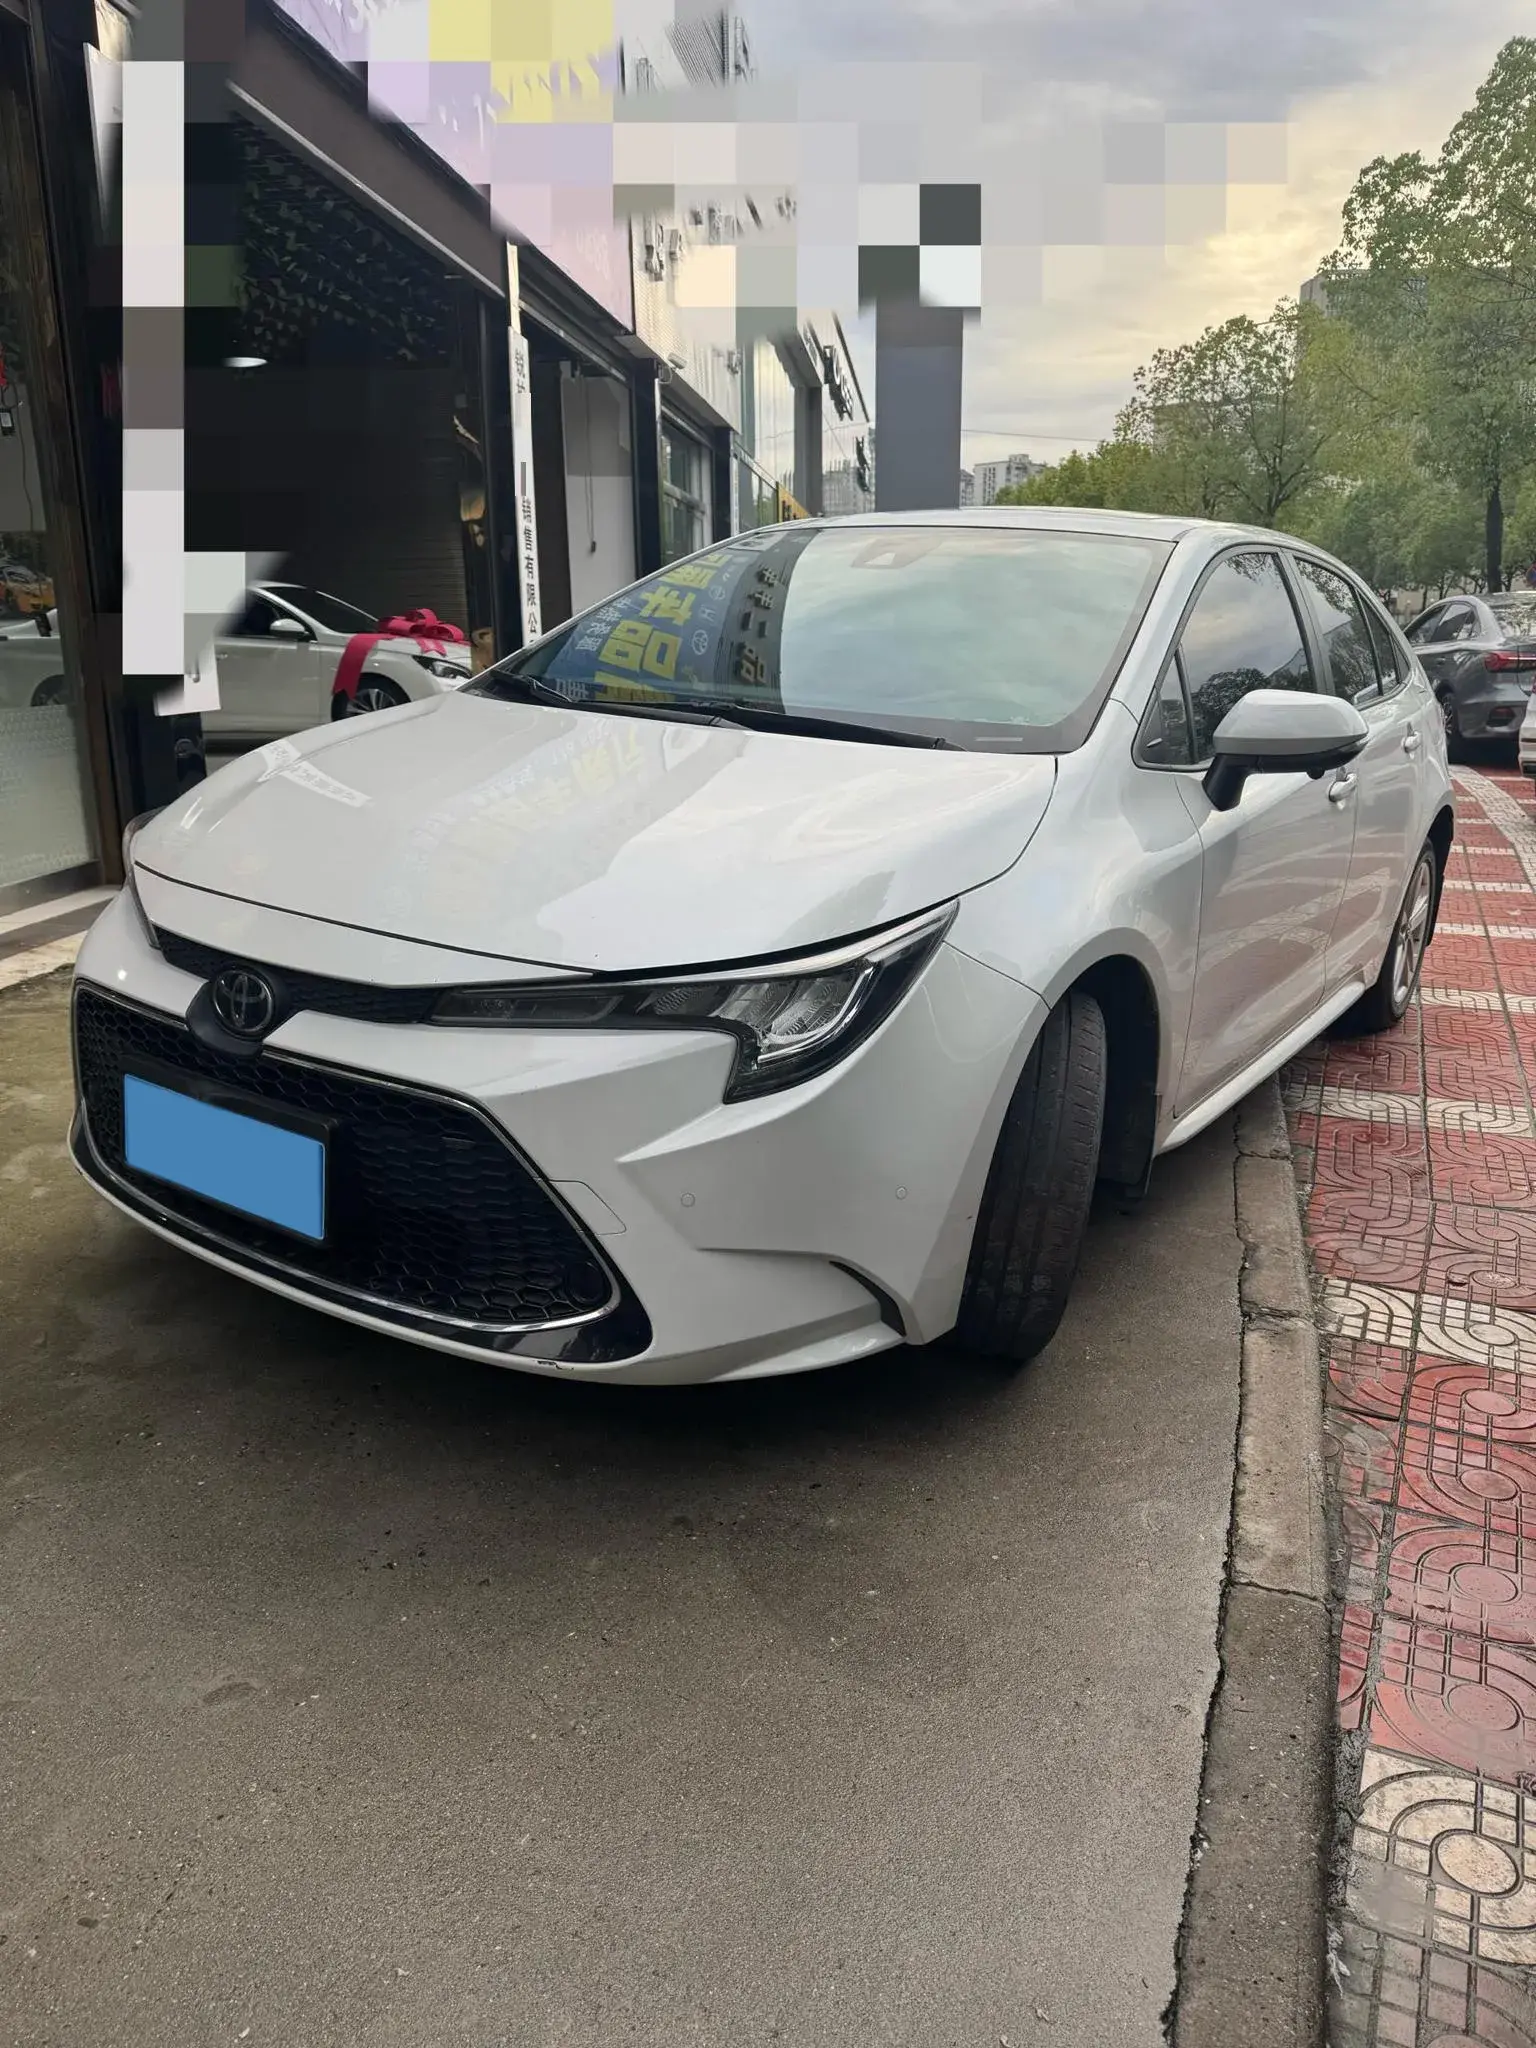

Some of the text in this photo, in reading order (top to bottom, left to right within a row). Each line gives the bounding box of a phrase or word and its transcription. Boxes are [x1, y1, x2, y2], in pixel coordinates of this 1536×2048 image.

[521, 497, 539, 643] 销售有限公
